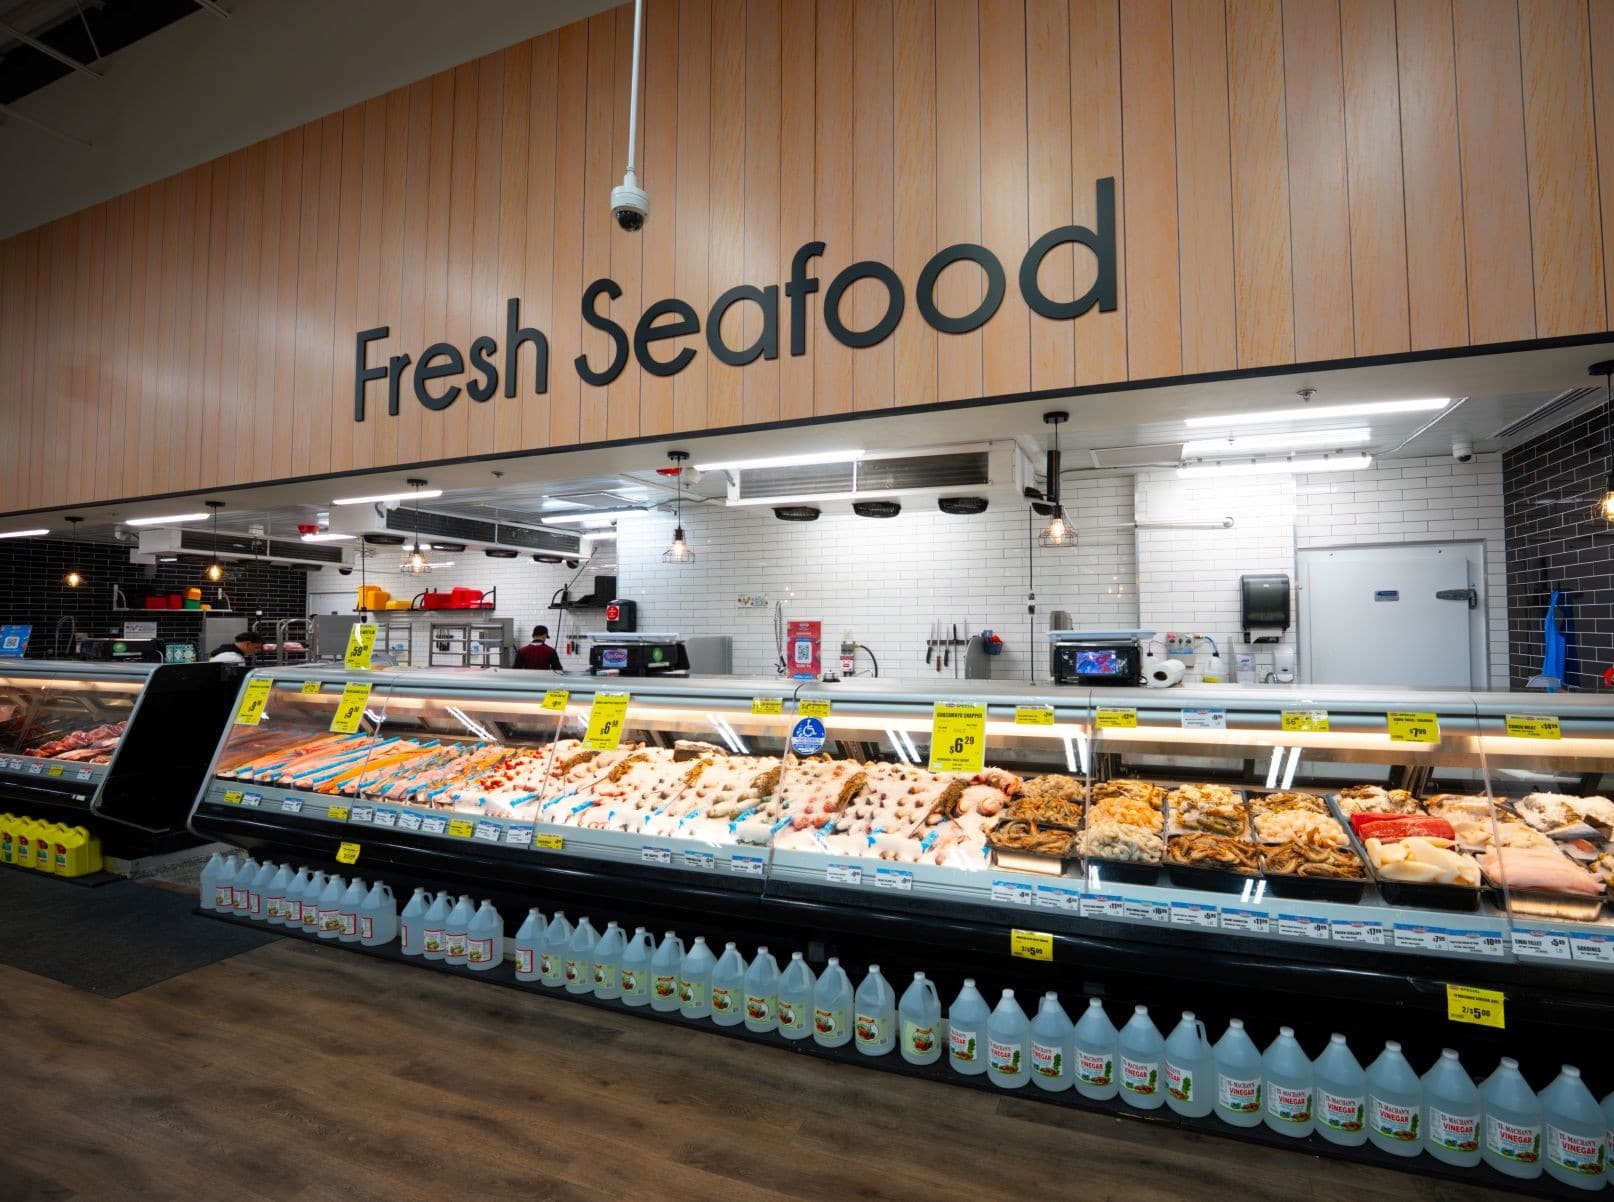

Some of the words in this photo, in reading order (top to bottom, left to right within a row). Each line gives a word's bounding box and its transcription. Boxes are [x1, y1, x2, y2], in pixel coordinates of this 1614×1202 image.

[354, 297, 549, 421] Fresh
[574, 176, 1118, 387] Seafood
[1229, 1087, 1255, 1097] VINEGAR
[1278, 1095, 1306, 1106] VINEGAR
[1327, 1102, 1356, 1114] VINEGAR
[1379, 1109, 1409, 1124] VINEGAR
[1443, 1122, 1473, 1134] VINEGAR
[1500, 1131, 1533, 1144] VINEGAR
[1562, 1142, 1596, 1156] VINEGAR
